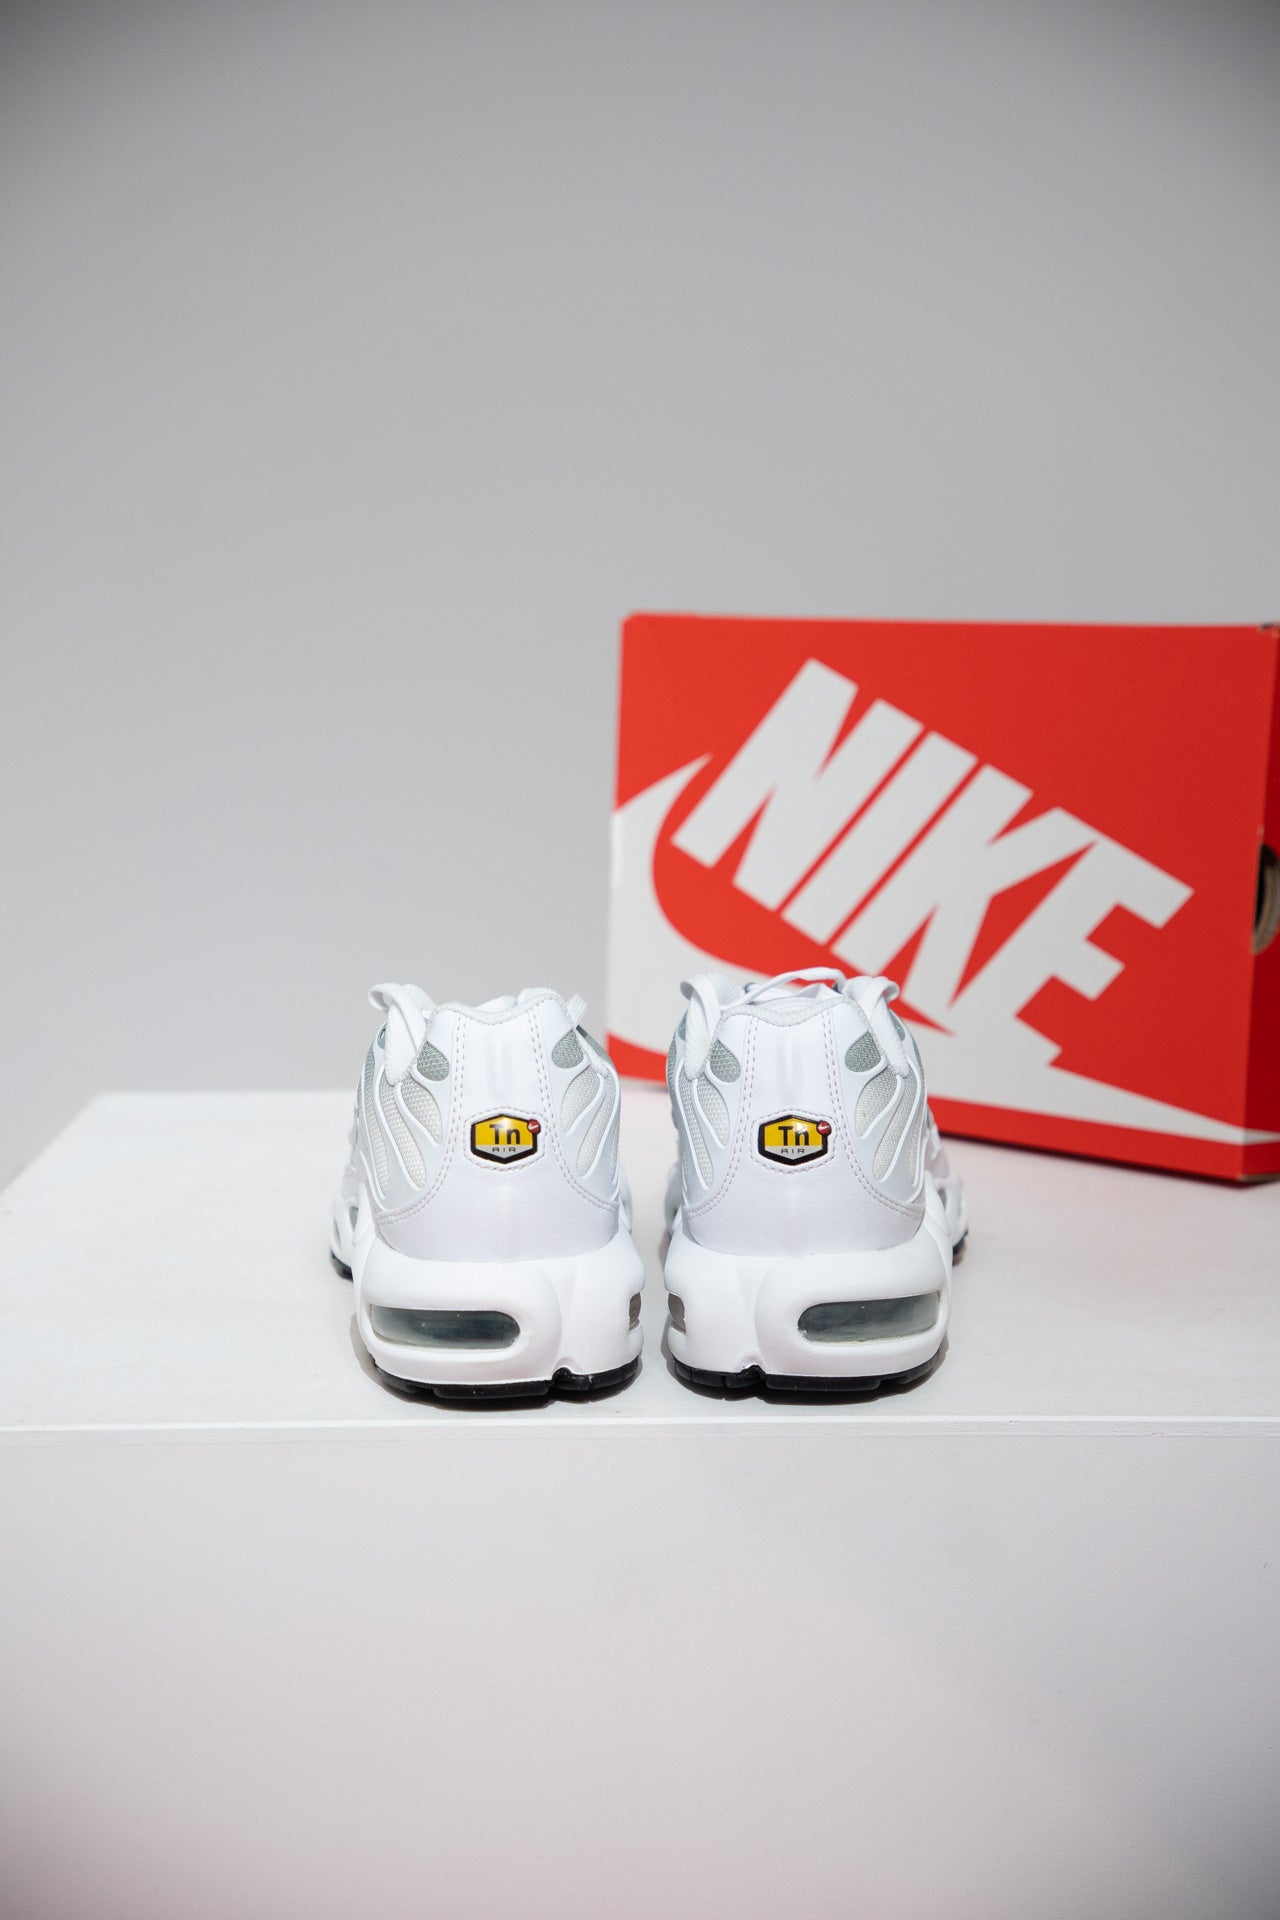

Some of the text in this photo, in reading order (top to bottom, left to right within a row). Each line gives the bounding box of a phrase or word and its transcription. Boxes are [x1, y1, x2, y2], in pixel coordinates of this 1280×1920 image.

[670, 656, 1194, 1064] NIKE
[489, 1124, 520, 1144] Tn
[778, 1126, 809, 1146] Tn
